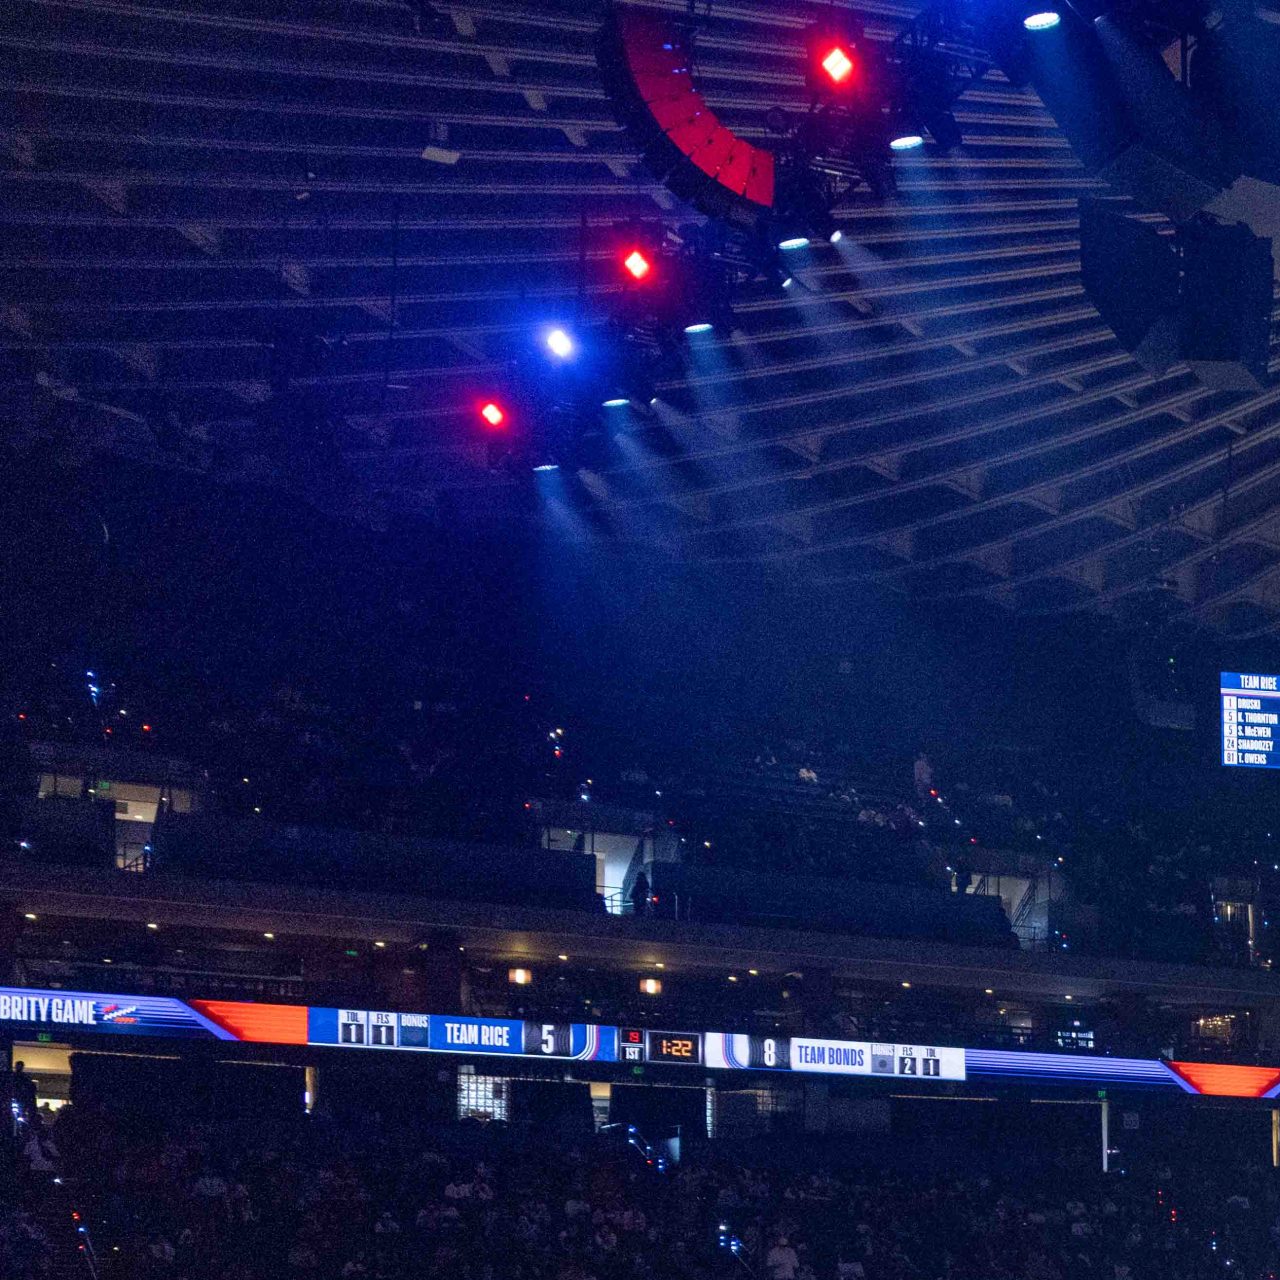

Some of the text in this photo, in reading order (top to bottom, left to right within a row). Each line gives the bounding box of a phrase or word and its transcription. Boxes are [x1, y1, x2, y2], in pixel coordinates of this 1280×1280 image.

[1240, 675, 1277, 690] TEAM RICE
[52, 999, 96, 1025] GAME
[376, 1013, 390, 1024] FLS
[349, 1025, 386, 1045] 1 1
[445, 1023, 555, 1054] TEAM RICE 5
[629, 1031, 640, 1043] 19
[625, 1039, 692, 1060] 1ST 1:22
[764, 1039, 864, 1067] 8 TEAM BONDS
